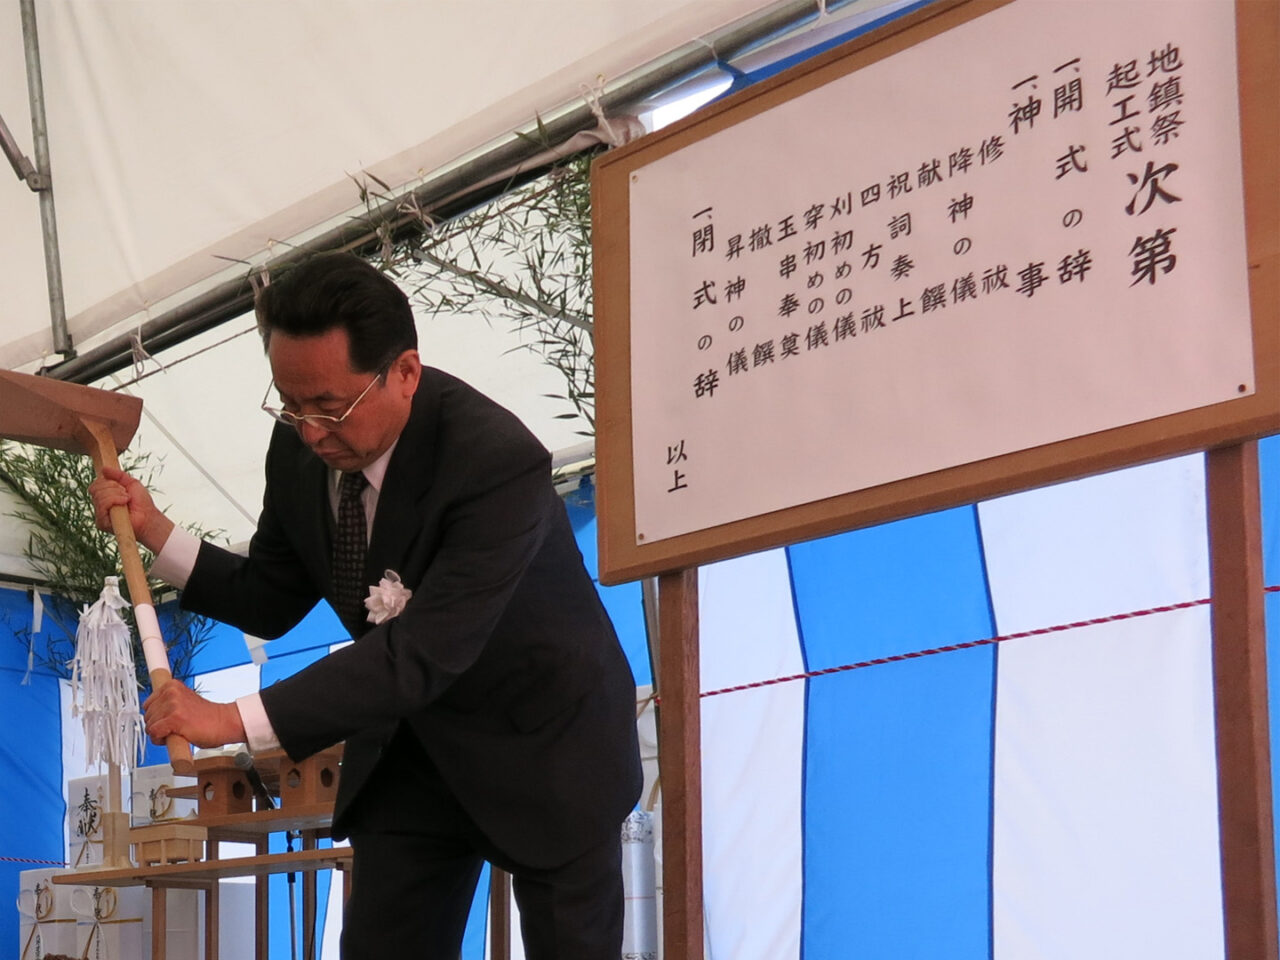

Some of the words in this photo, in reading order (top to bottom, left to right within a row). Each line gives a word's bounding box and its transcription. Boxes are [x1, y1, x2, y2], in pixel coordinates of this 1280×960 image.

[1105, 59, 1144, 160] 起工式
[1146, 42, 1186, 146] 地鎮祭
[777, 215, 801, 358] 玉串奉奠
[802, 204, 829, 351] 穿初めの儀
[829, 192, 857, 342] 刈初めの儀
[860, 183, 887, 334] 四方祓
[886, 171, 916, 322] 祝詞奏上
[948, 147, 977, 304] 降神の儀
[1125, 160, 1183, 287] 次第
[724, 235, 748, 376] 昇神の儀
[666, 439, 688, 493] 以上
